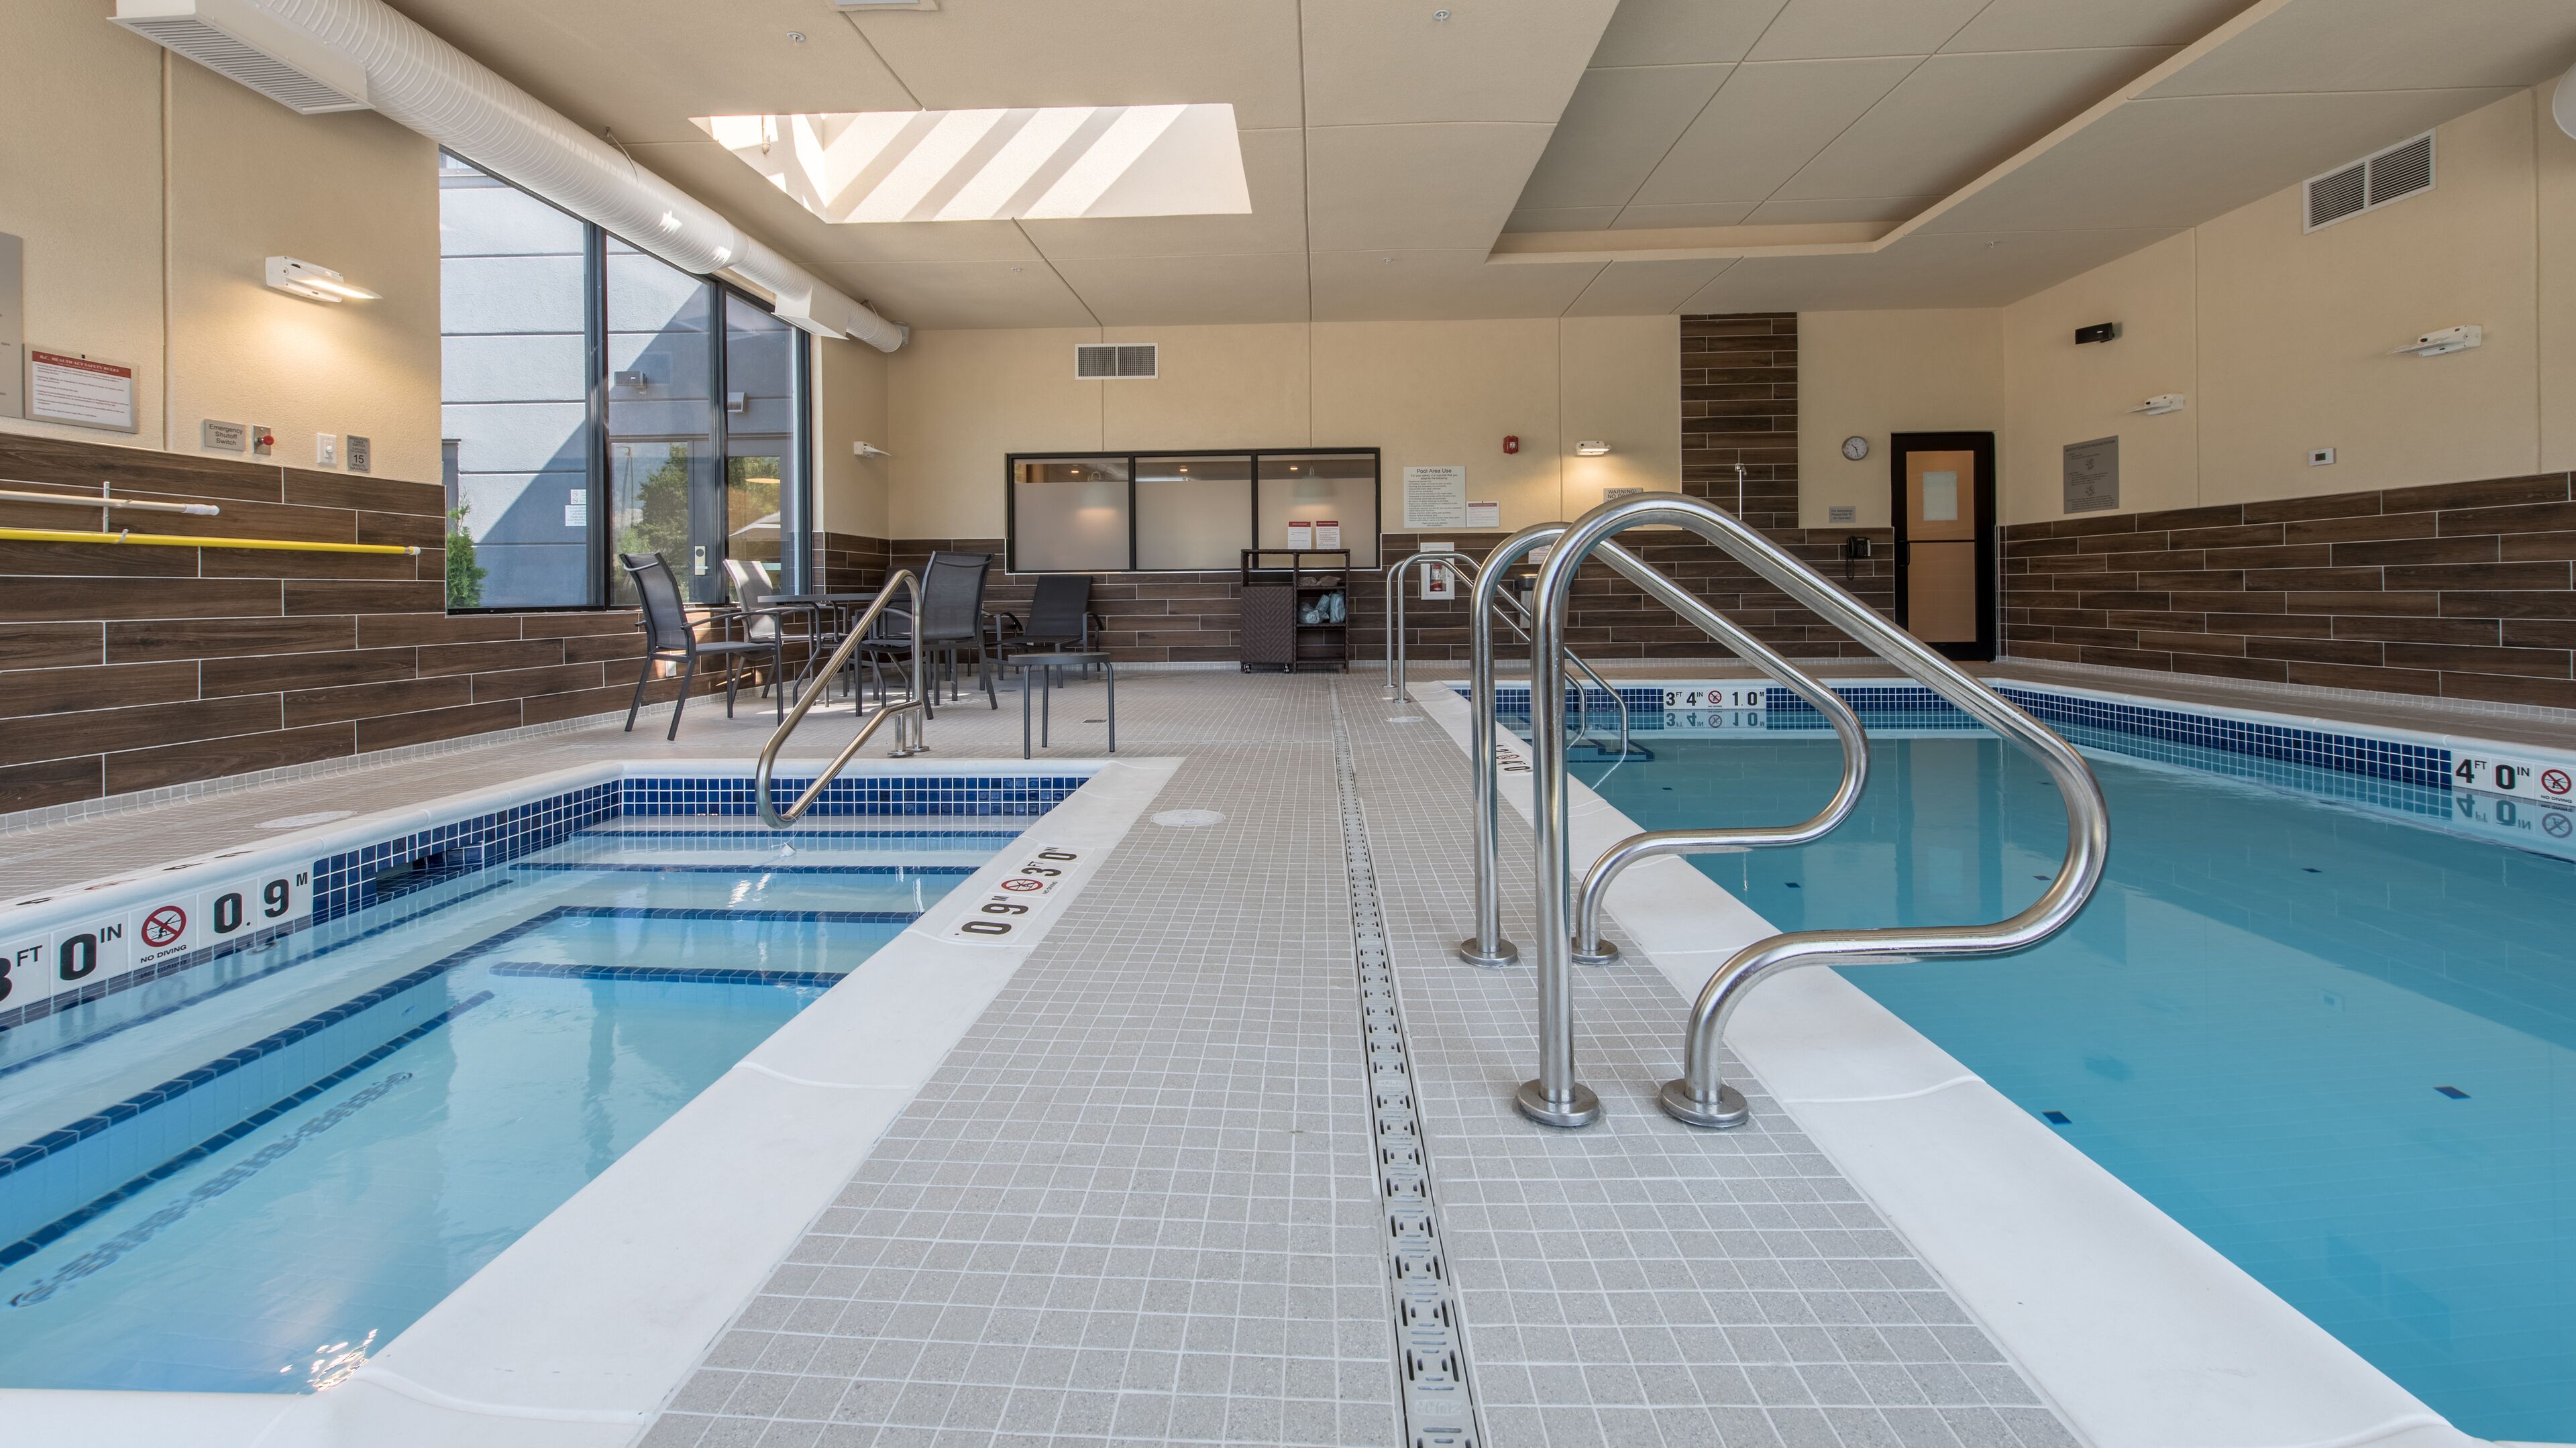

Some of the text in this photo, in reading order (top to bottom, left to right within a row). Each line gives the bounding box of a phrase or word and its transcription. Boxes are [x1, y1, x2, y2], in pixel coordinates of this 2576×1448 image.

[209, 423, 243, 435] Emergency
[215, 431, 237, 439] Shutoff
[216, 438, 237, 446] Switch
[354, 454, 364, 464] 15
[1666, 691, 1676, 706] 3
[1686, 691, 1697, 706] 4
[2455, 759, 2530, 789] 4 FT 0 IN
[296, 871, 308, 887] M
[17, 923, 123, 981] FT 0 IN
[140, 944, 187, 964] NO DIVING
[1416, 1400, 1462, 1416] ZURN
